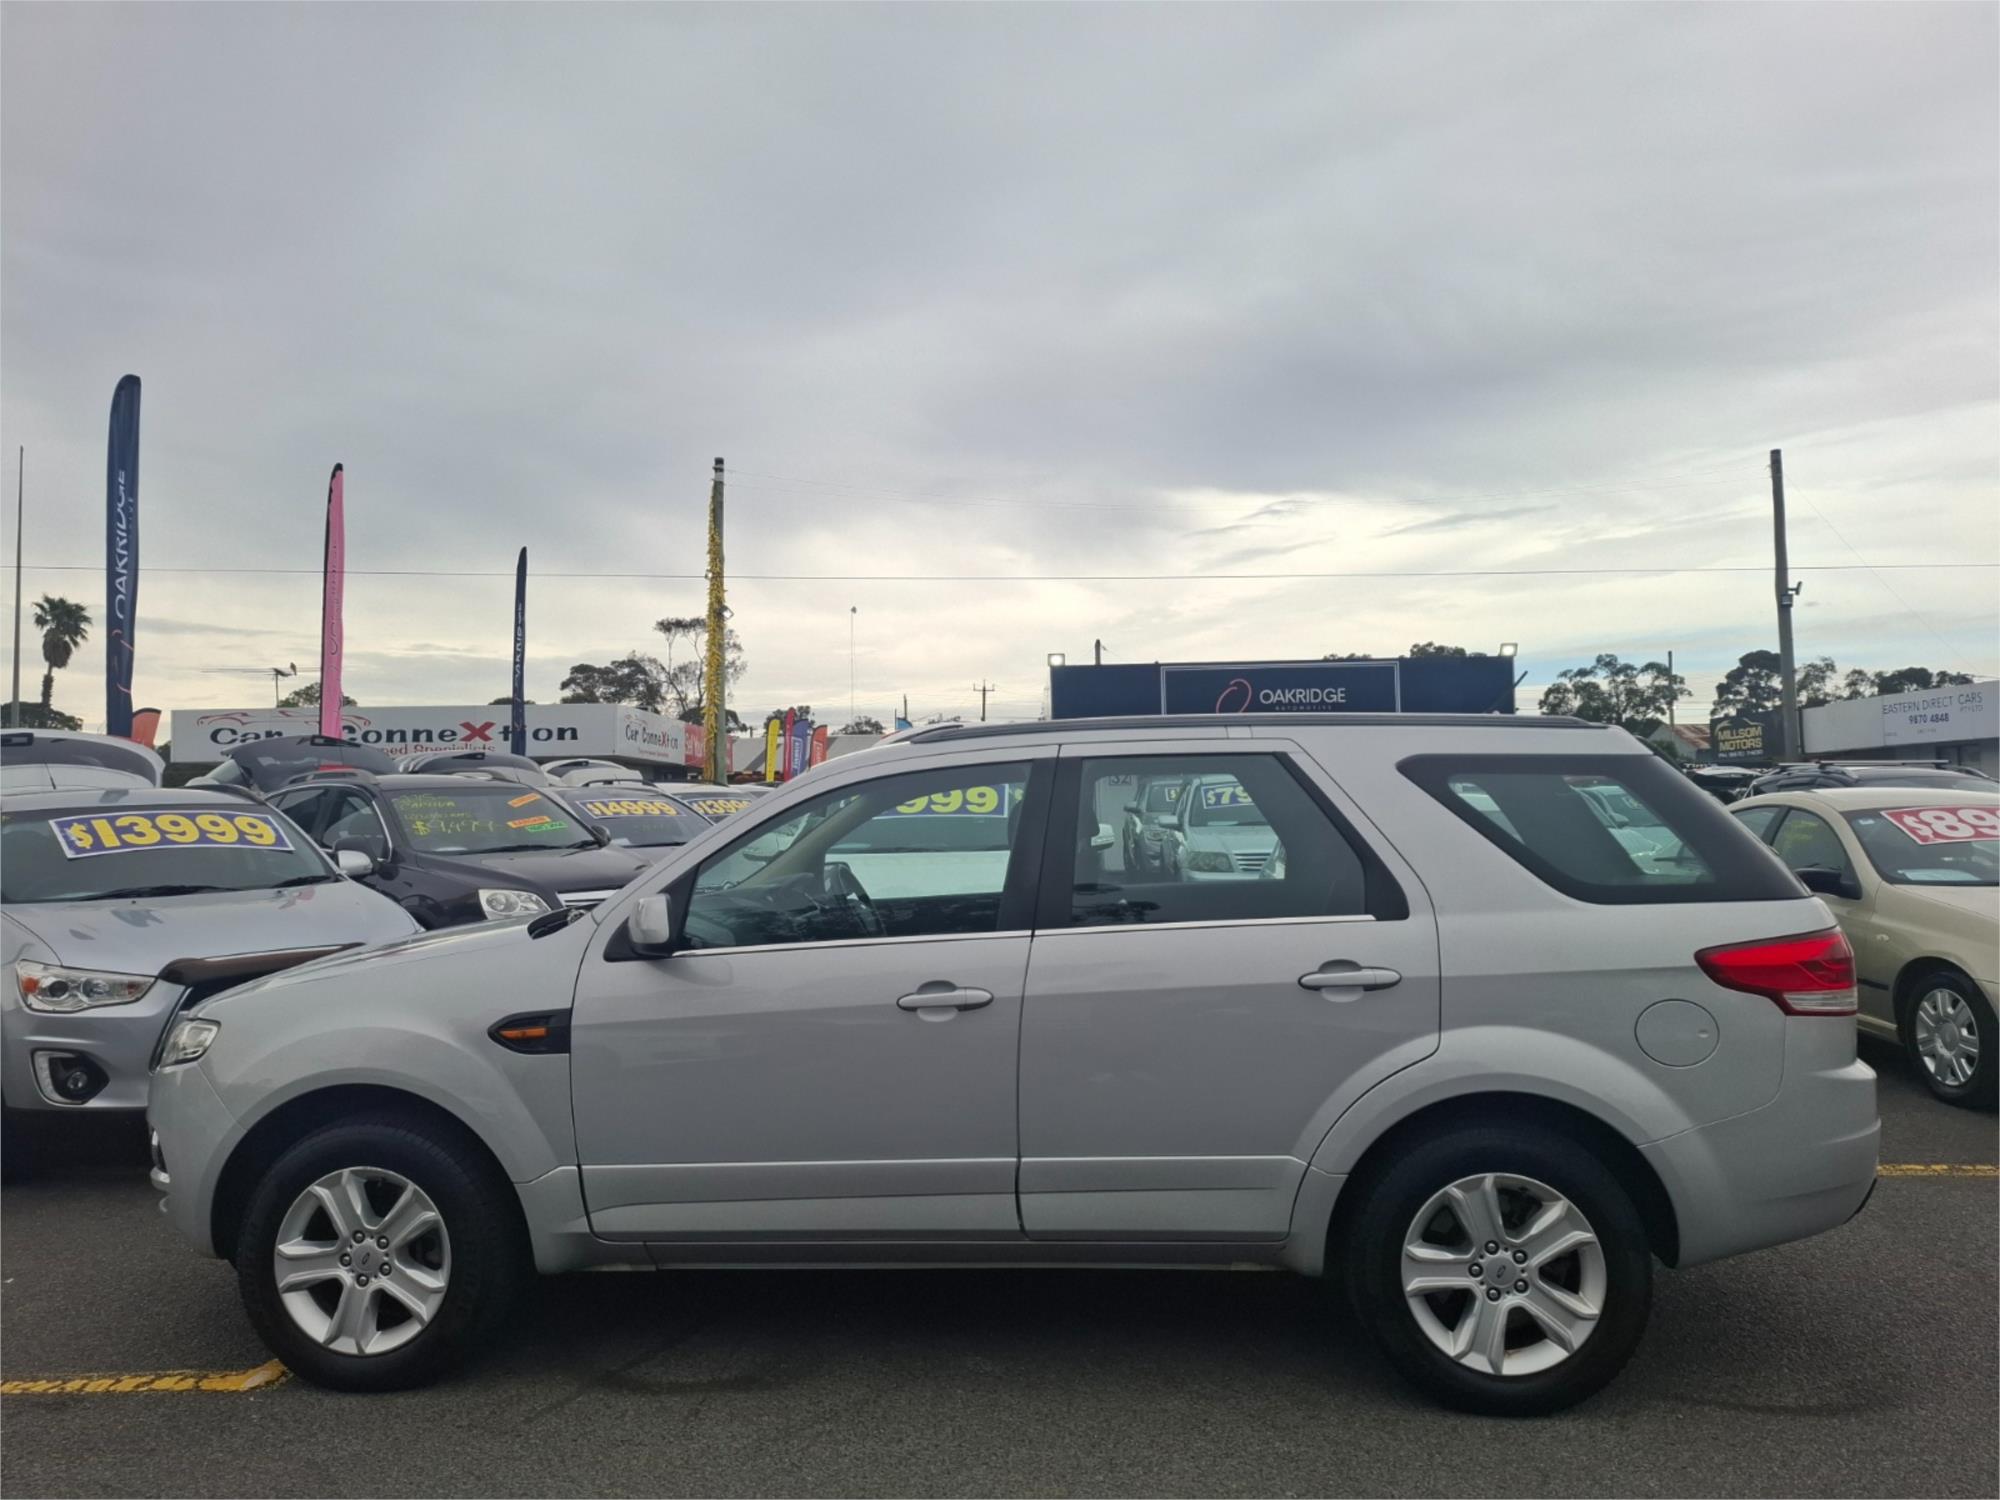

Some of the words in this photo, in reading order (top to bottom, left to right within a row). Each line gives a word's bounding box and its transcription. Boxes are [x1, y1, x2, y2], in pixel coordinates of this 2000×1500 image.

[1259, 687, 1347, 704] OAKRIDGE
[1882, 702, 1920, 714] EASTERN
[1922, 695, 1954, 710] DIRECT
[1957, 692, 1983, 705] CARS
[1908, 714, 1927, 724] 9870
[209, 727, 283, 746] Car
[342, 721, 578, 744] ConneXton
[625, 724, 639, 741] Car
[1718, 726, 1763, 741] MILLSOM
[1719, 737, 1763, 752] MOTORS
[585, 800, 678, 816] $14999
[67, 813, 277, 849] $13999
[1902, 809, 2000, 839] $89
